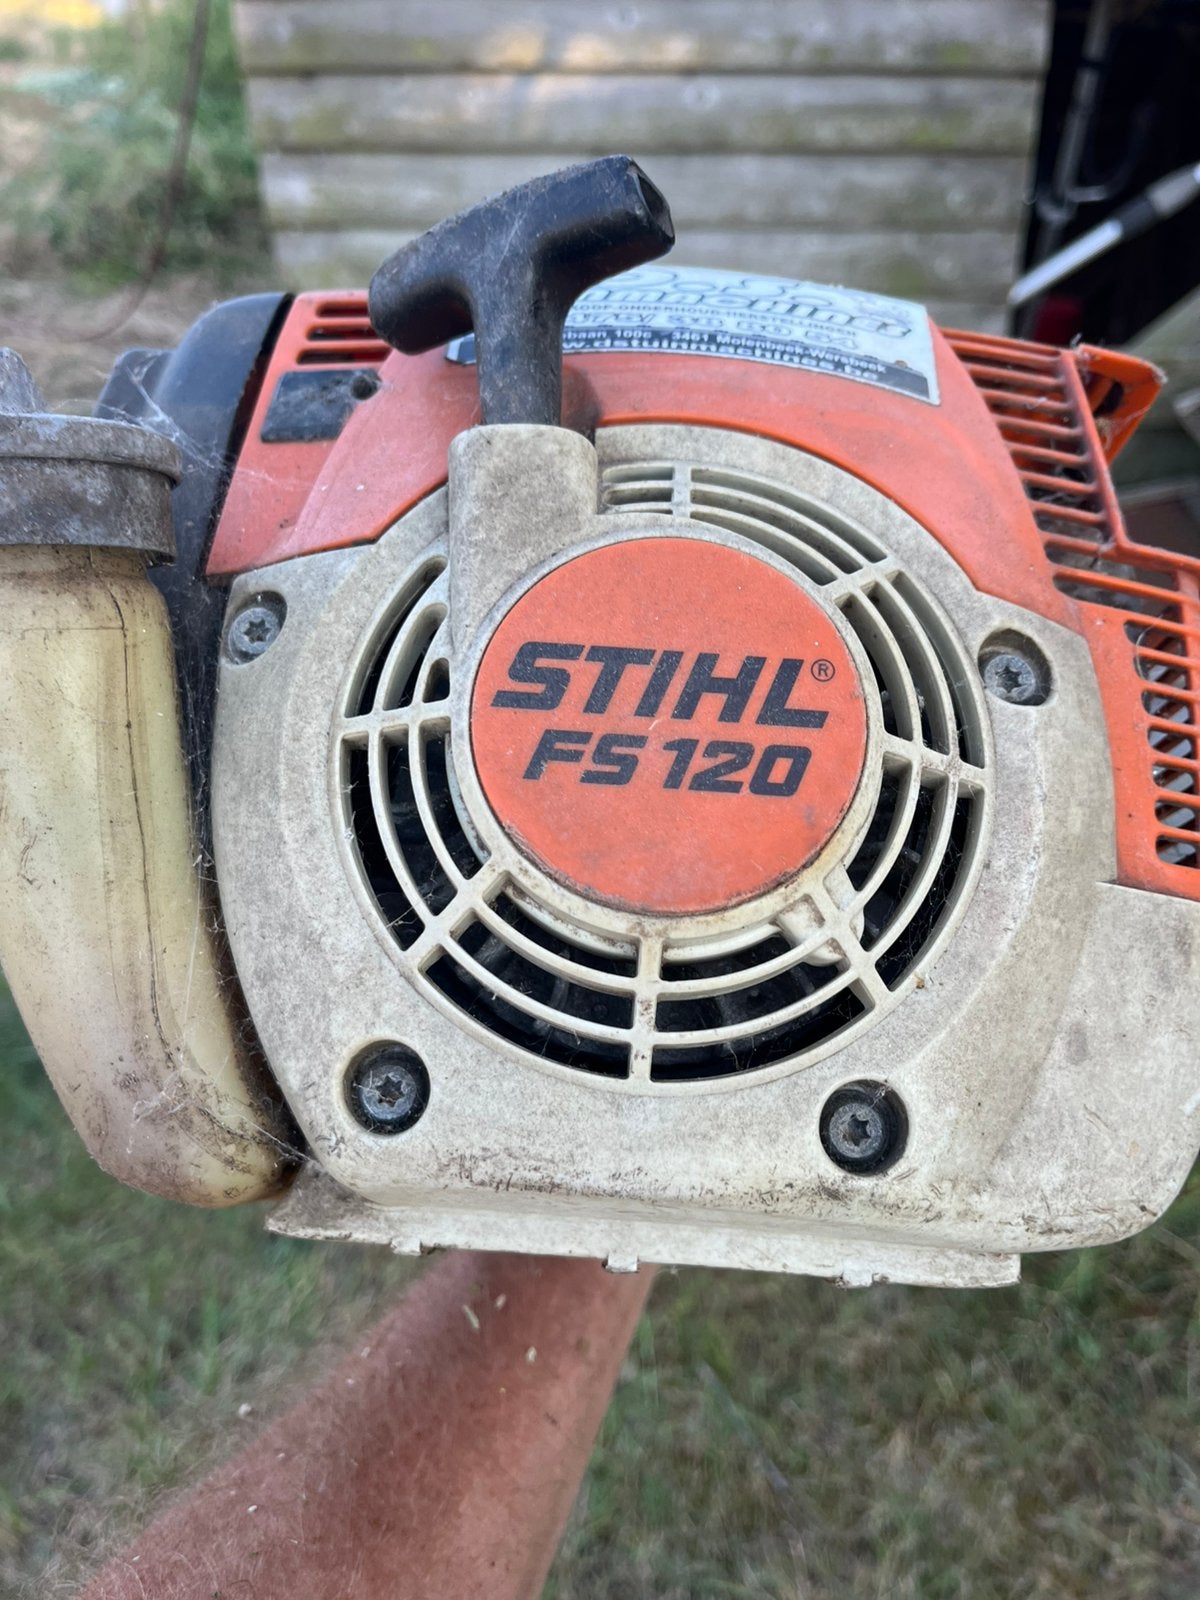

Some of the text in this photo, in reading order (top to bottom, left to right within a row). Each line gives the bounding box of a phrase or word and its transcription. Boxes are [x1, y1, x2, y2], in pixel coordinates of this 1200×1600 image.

[562, 330, 607, 340] baan
[562, 338, 878, 381] w.dstuinmachines.be
[491, 641, 829, 729] STIHL
[522, 729, 812, 797] FS 120
